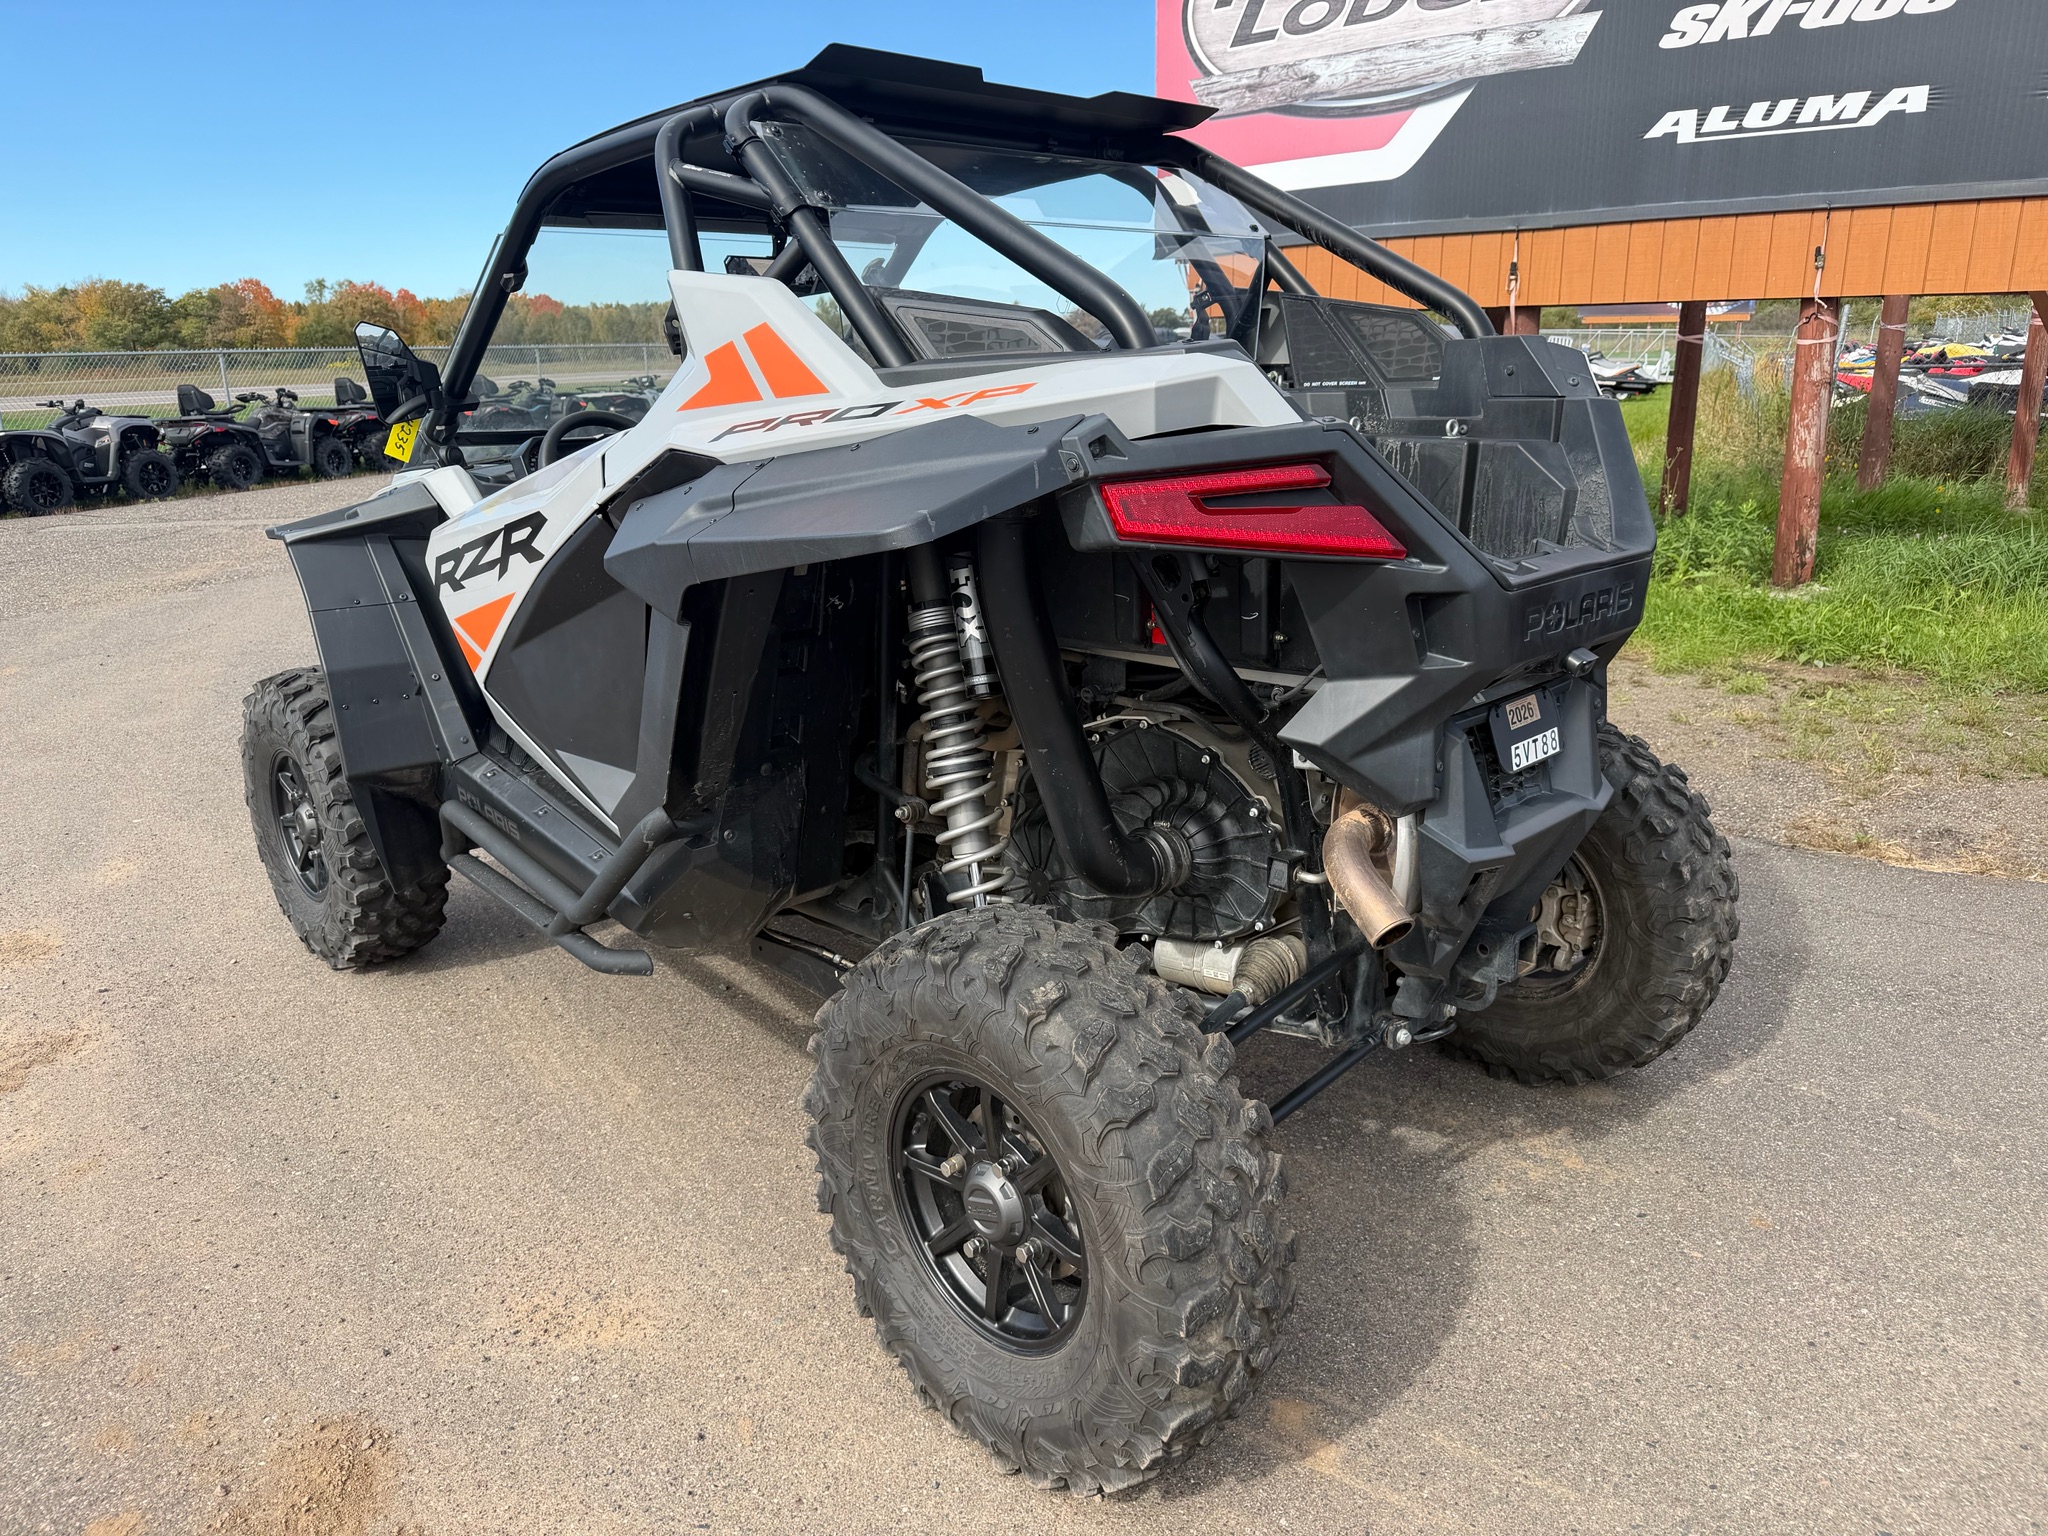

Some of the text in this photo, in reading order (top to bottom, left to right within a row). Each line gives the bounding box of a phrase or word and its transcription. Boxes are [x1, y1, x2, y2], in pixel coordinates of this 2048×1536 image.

[1643, 85, 1930, 144] ALUMA
[708, 382, 1039, 443] PRO XP
[434, 510, 548, 597] RZR
[949, 563, 988, 648] FOX
[1523, 581, 1635, 642] POLARIS
[1508, 701, 1535, 726] 2026
[1513, 729, 1558, 768] 5VT88
[456, 784, 520, 841] POLARIS
